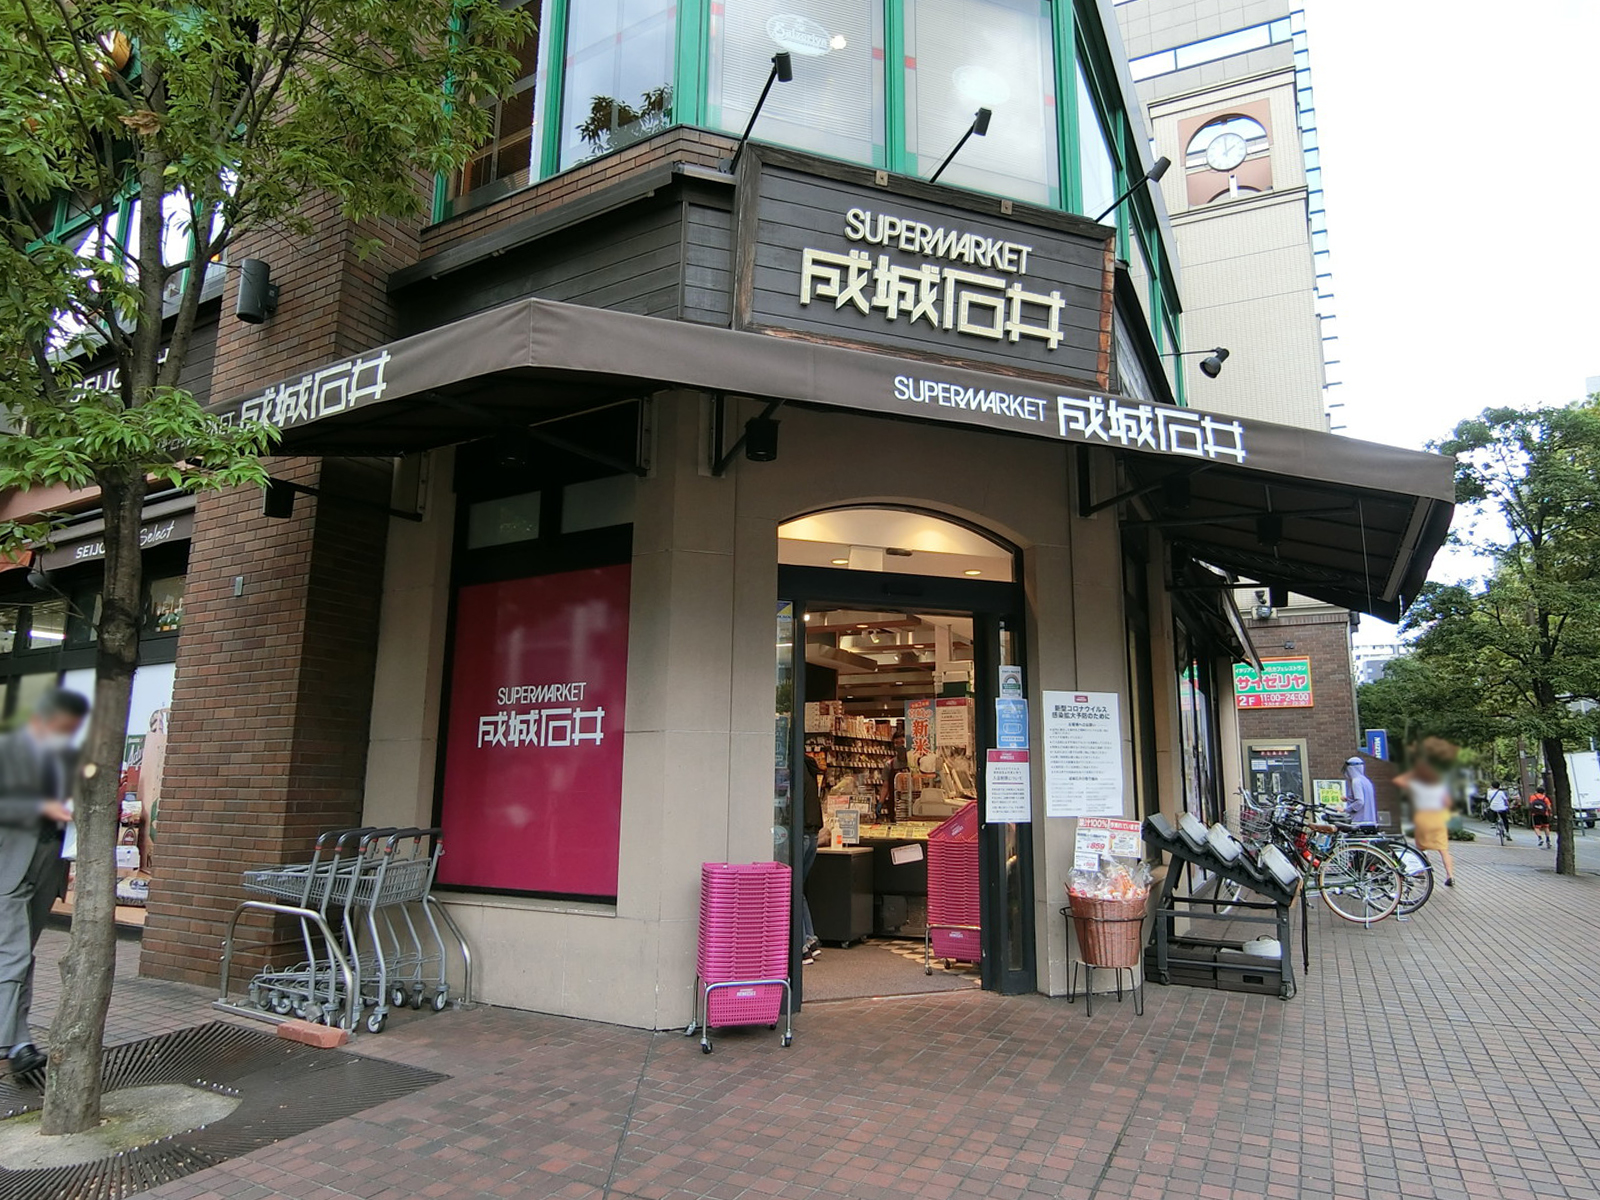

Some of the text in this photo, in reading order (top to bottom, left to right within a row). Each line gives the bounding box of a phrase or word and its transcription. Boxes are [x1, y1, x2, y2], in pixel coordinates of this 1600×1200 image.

[844, 208, 1033, 275] SUPERMARKET
[799, 248, 1066, 350] 成城石井
[240, 350, 391, 434] 成城石井
[893, 375, 1247, 464] SUPERMARKET 成城石井
[139, 520, 175, 546] Select
[497, 682, 587, 705] SUPERMARKET
[1236, 674, 1307, 691] サイゼリヤ
[1239, 696, 1255, 706] 2F
[477, 706, 605, 748] 成城石井
[1052, 712, 1110, 720] 感染拡大予防のために
[911, 718, 930, 756] 新米
